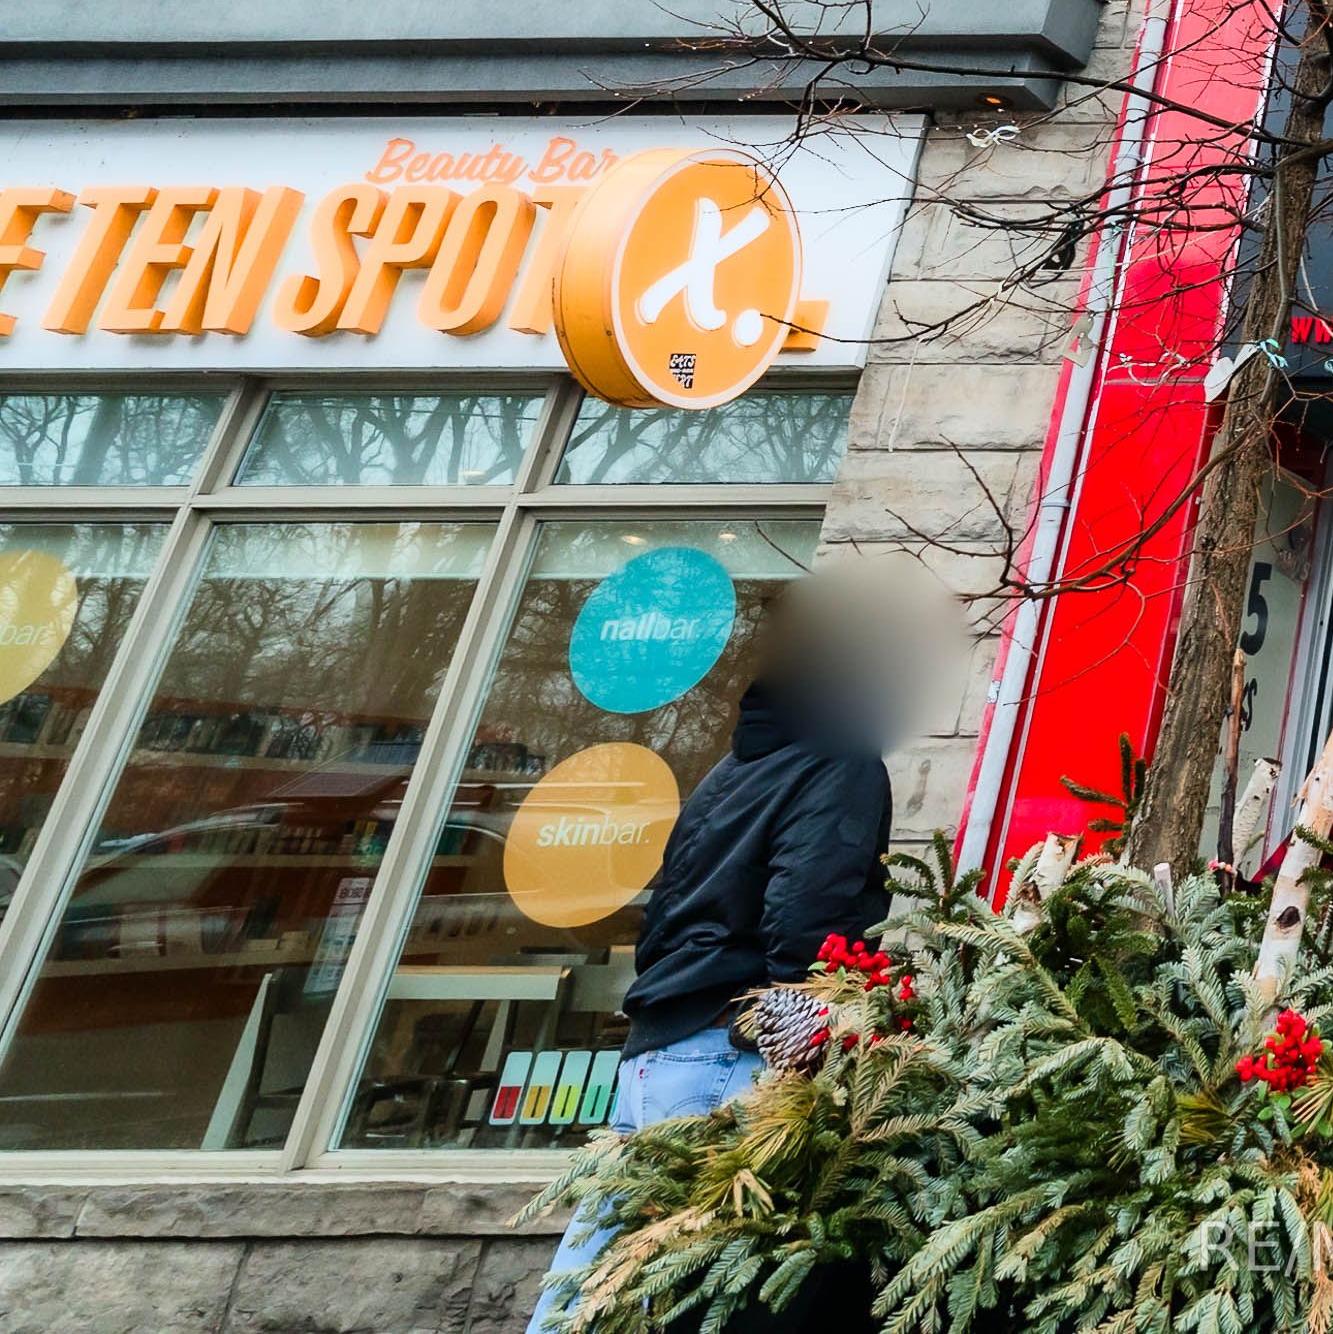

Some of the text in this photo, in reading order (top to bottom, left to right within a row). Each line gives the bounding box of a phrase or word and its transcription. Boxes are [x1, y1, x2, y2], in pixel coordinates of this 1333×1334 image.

[365, 137, 623, 185] Beauty Bar
[41, 185, 305, 336] TEN
